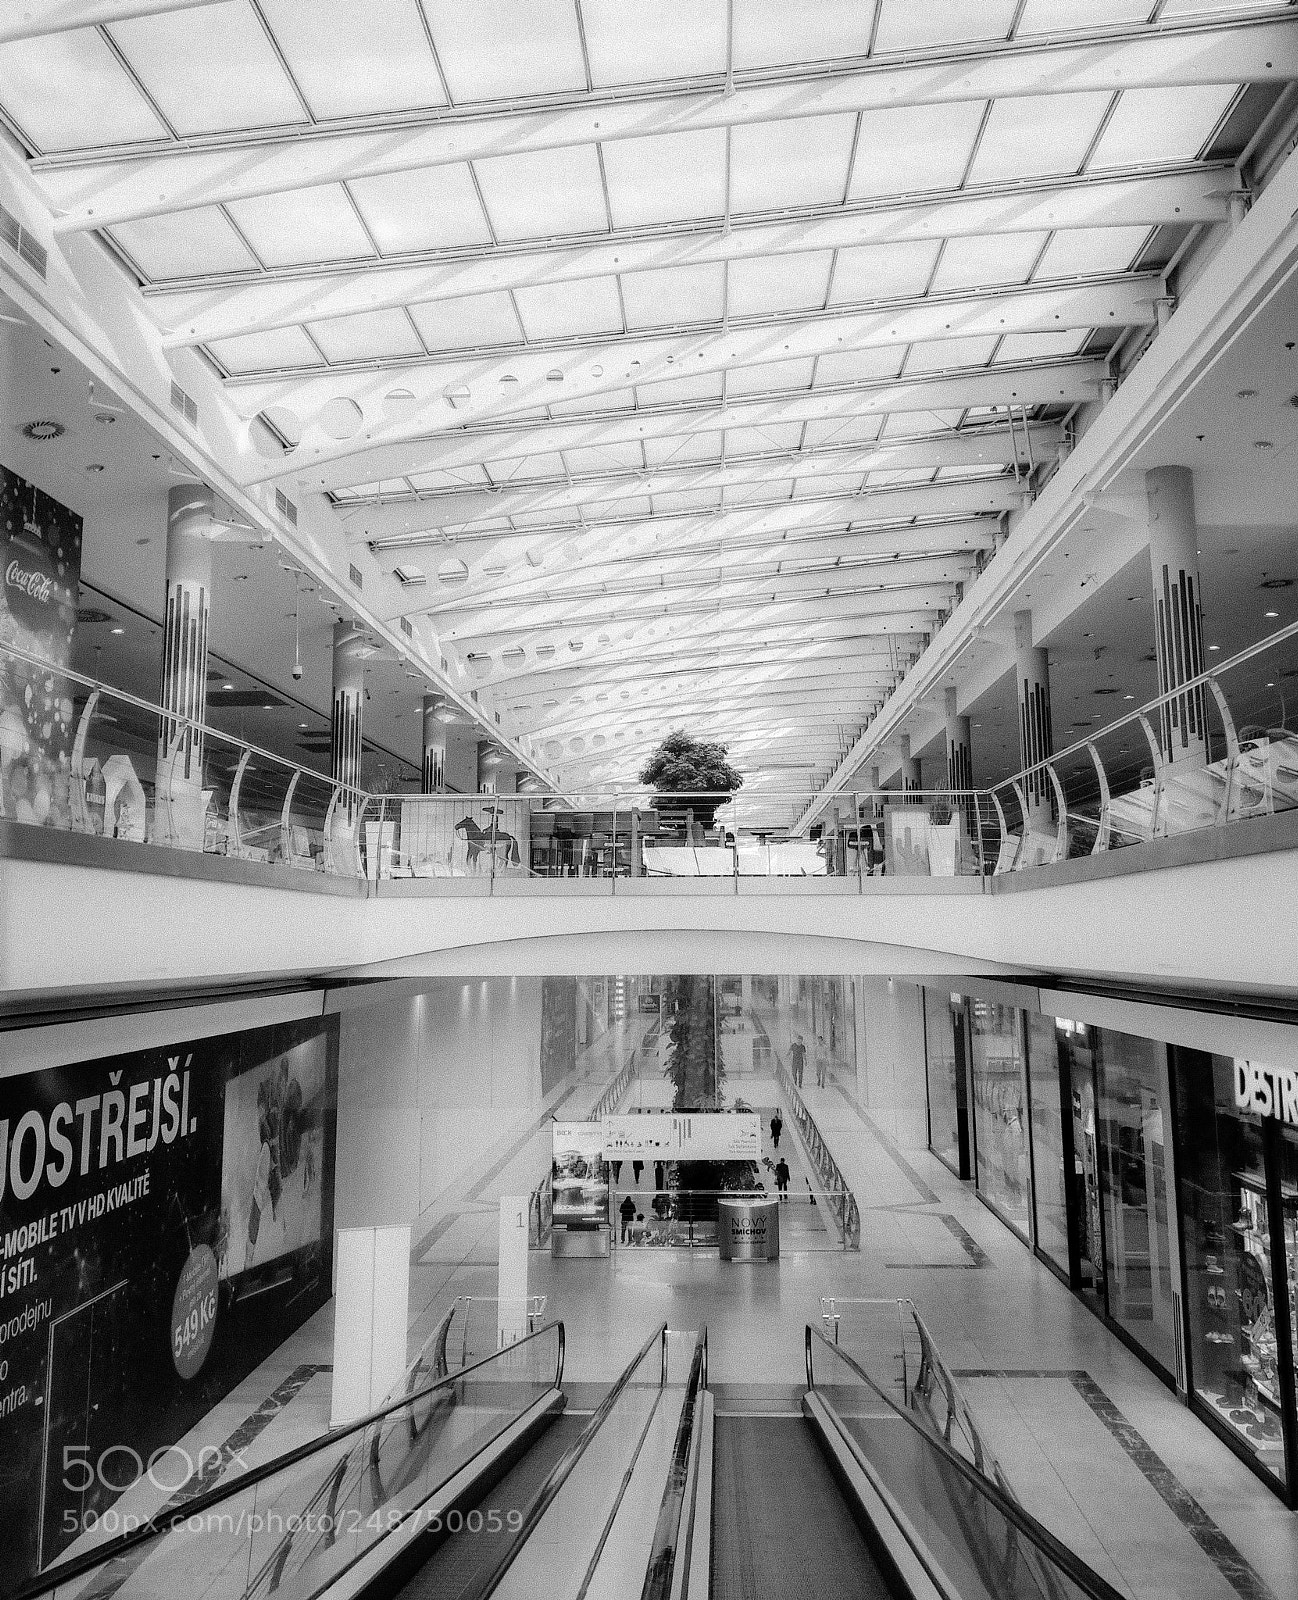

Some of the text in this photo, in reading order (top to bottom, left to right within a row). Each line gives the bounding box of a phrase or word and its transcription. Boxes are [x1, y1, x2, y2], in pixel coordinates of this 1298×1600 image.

[0, 1211, 58, 1260] -MOBILE
[60, 1203, 77, 1233] TV
[87, 1193, 105, 1221] HD
[106, 1167, 150, 1213] KVALITĚ
[731, 1214, 768, 1228] NOVÝ
[7, 1256, 38, 1294] SÍTI.
[175, 1309, 199, 1358] 549
[200, 1289, 216, 1331] Kč
